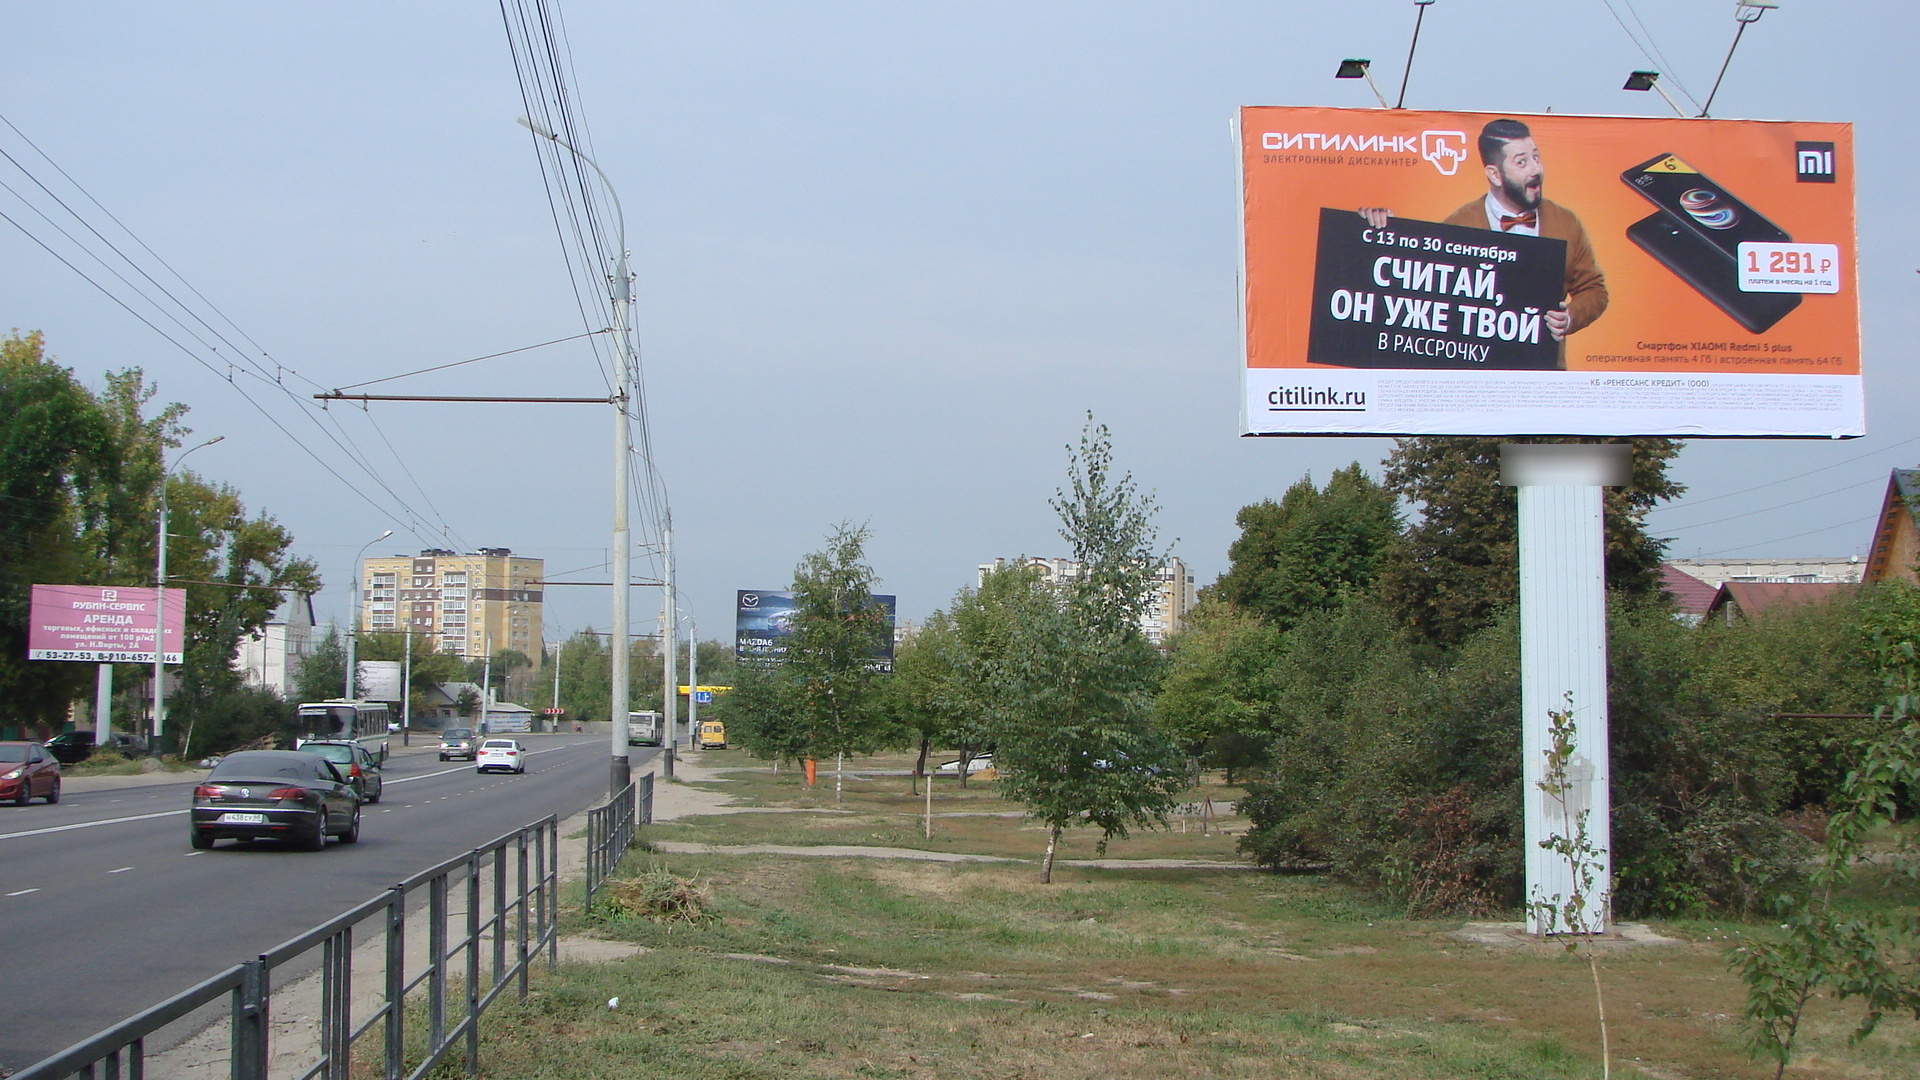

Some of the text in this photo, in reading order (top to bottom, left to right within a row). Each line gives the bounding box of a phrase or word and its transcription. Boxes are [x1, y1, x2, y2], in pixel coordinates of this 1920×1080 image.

[1262, 132, 1418, 153] СИТИЛИНК
[1263, 154, 1418, 167] ЭЛЕКТРОННЫЙ ДИСКАУНТЕР
[1377, 231, 1395, 246] 13
[1399, 236, 1418, 249] по
[1423, 237, 1442, 252] 30
[1445, 241, 1517, 262] сентября
[1747, 251, 1760, 272] 1
[1770, 251, 1815, 273] 291
[1372, 256, 1504, 307] СЧИТАЙ,
[1330, 289, 1541, 345] ОН УЖЕ ТВОЙ
[1378, 332, 1490, 363] В РАССРОЧКУ
[1637, 341, 1793, 353] Смартфон XIAOMI Redmi 5 plus
[1586, 354, 1651, 364] оперативная
[1654, 355, 1690, 363] память
[1692, 354, 1698, 363] 4
[1720, 356, 1777, 365] встроенная
[1780, 357, 1815, 365] память
[1817, 357, 1829, 365] 64
[1590, 379, 1601, 387] КБ
[1603, 379, 1649, 387] «РЕНЕССАНС
[1651, 379, 1685, 388] КРЕДИТ»
[1268, 386, 1366, 405] citilink.ru
[73, 602, 145, 611] РУБИН-СЕРВИС
[83, 614, 133, 626] АРЕНДА
[43, 625, 84, 633] торговых,
[86, 625, 121, 633] офисных
[75, 641, 87, 649] ул.
[46, 651, 177, 662] 53-27-53, 8-910-657-66
